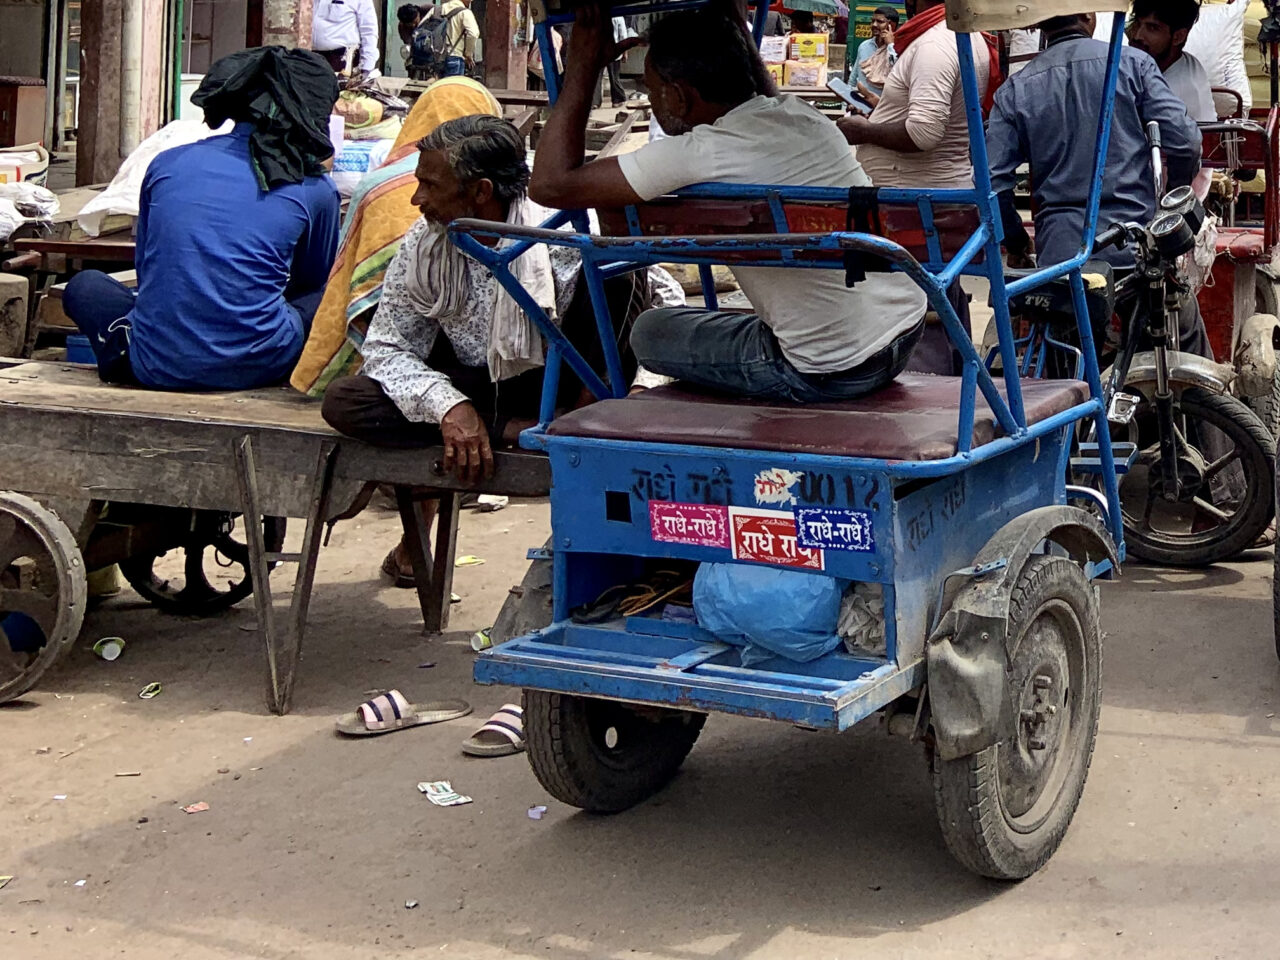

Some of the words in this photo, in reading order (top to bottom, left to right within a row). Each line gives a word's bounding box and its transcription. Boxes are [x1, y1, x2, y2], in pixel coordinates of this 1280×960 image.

[1024, 294, 1051, 309] TVS
[661, 510, 717, 538] राधे-राधे
[806, 515, 863, 543] राधे-राधे
[741, 525, 776, 556] राधे
